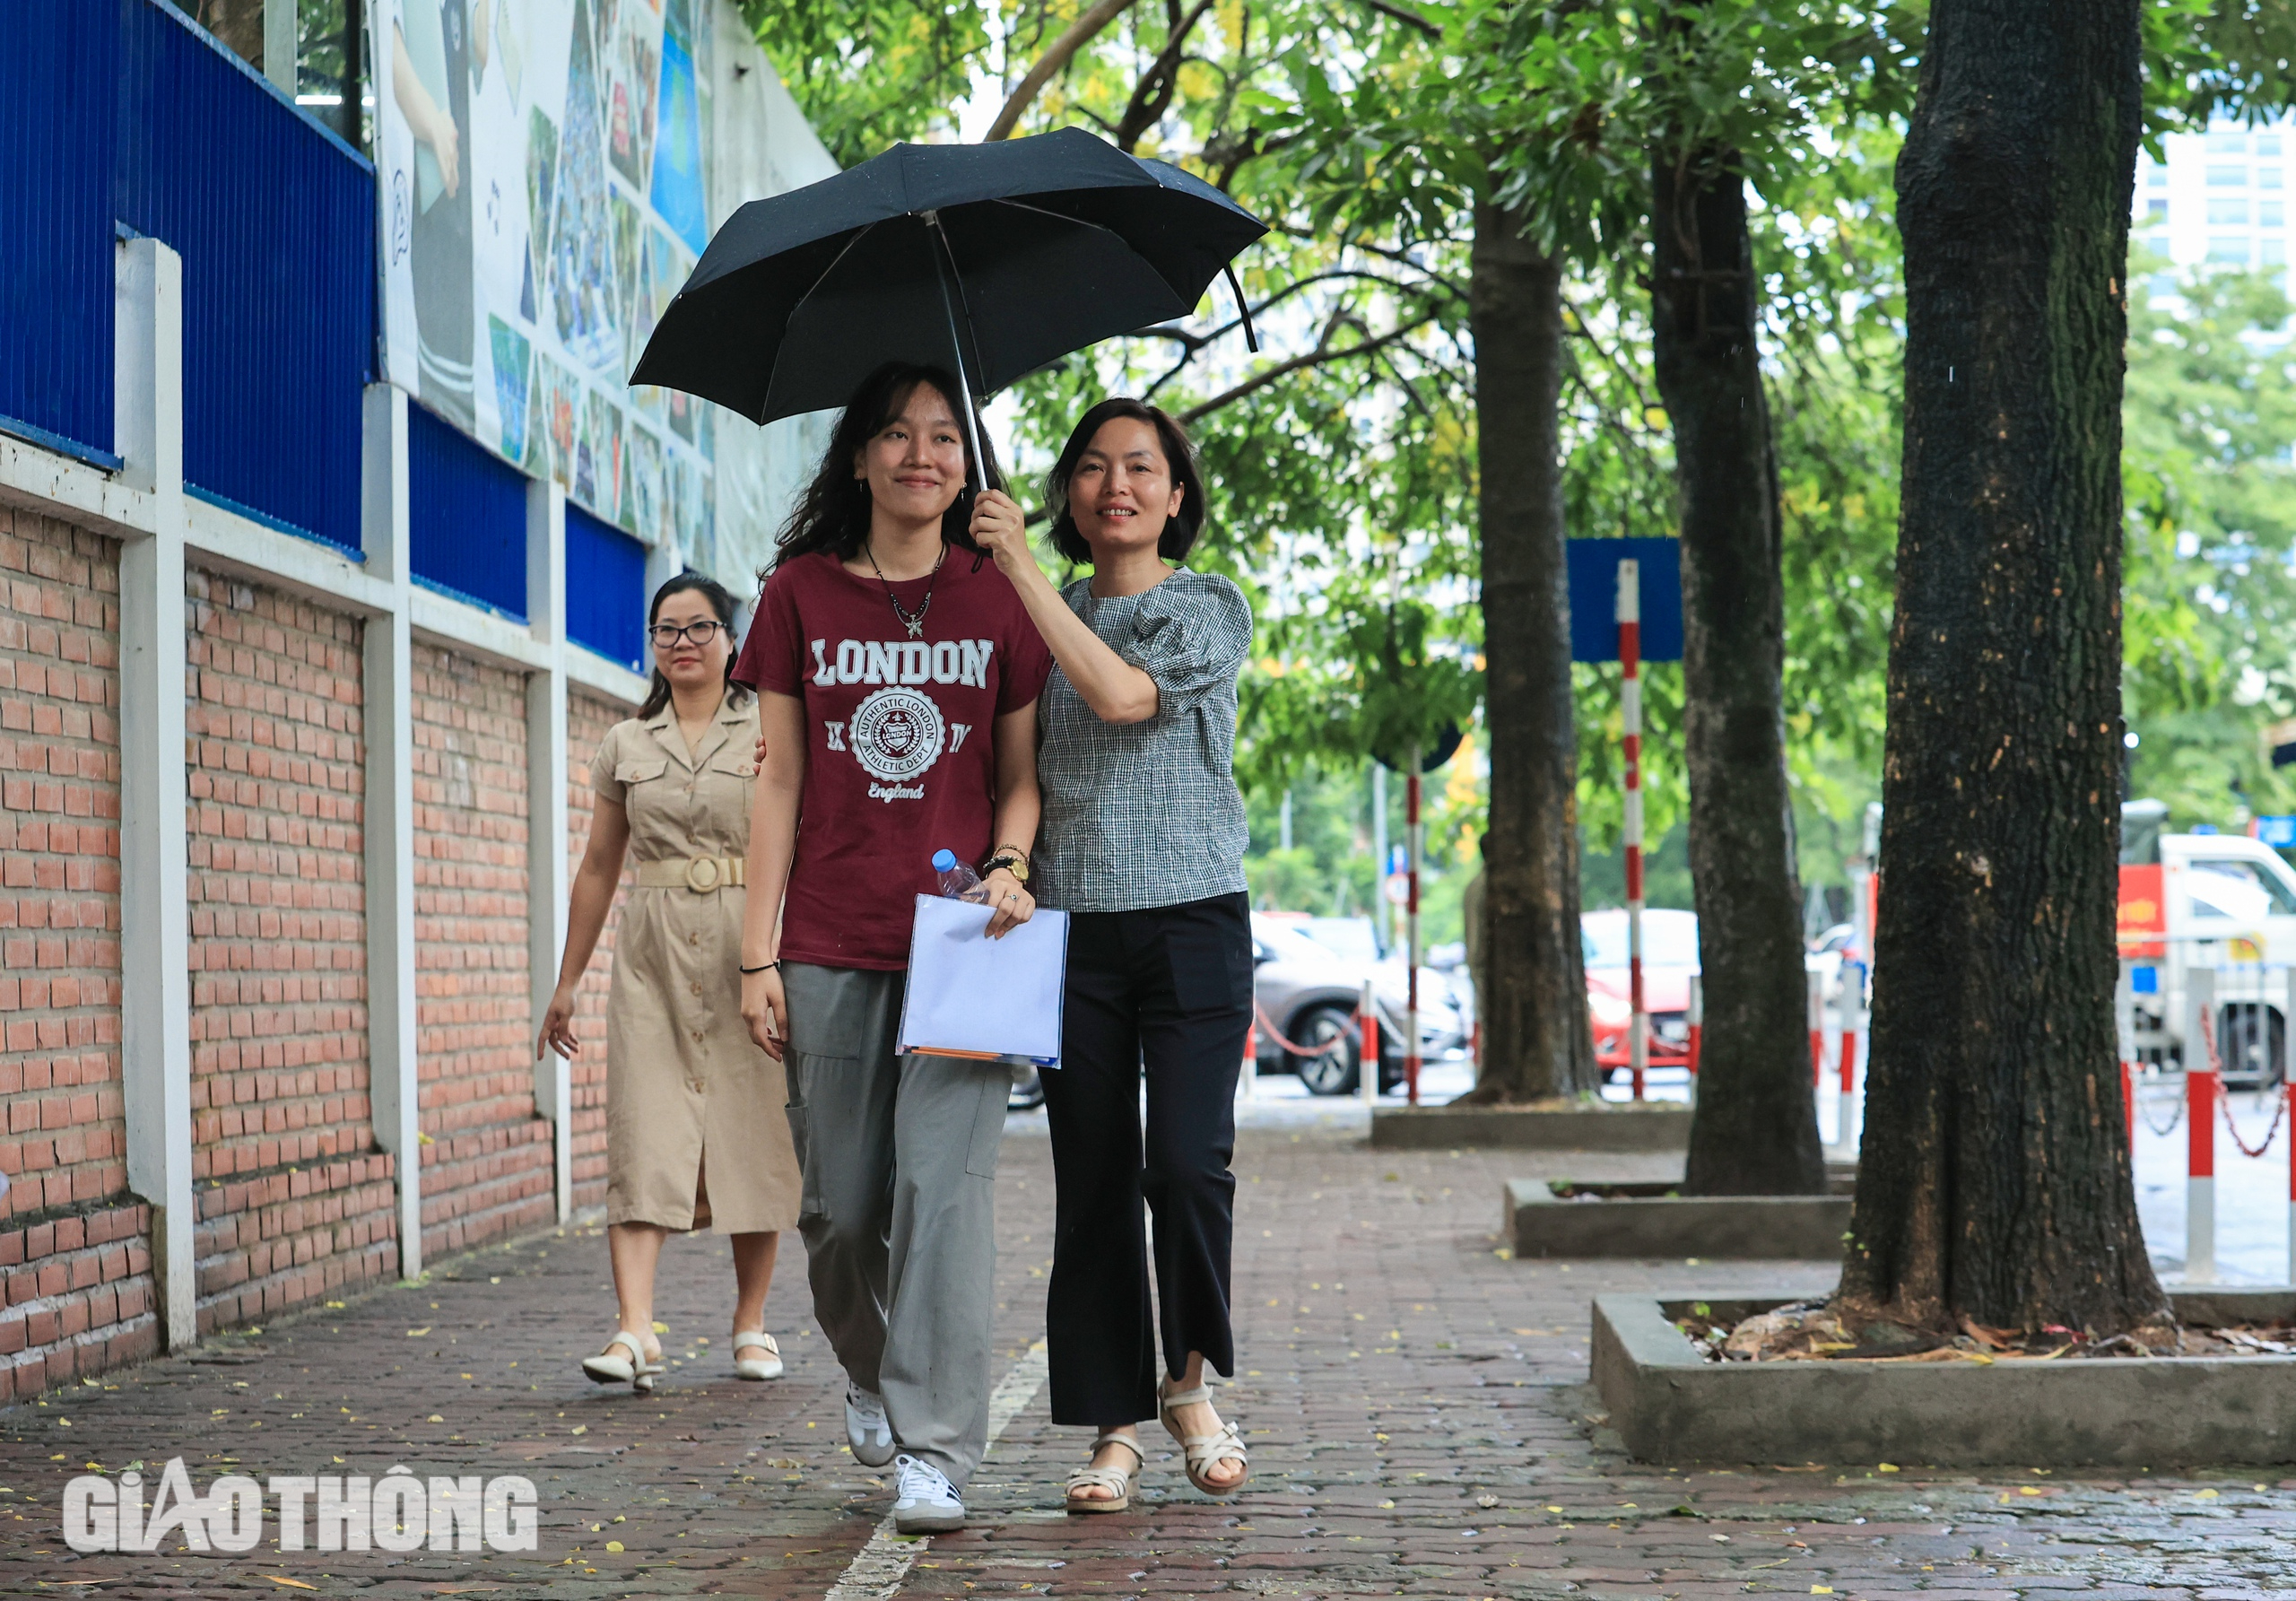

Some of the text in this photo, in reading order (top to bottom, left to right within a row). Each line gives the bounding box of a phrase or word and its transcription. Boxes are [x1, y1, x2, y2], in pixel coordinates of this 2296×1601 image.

[812, 639, 994, 689] LONDON
[861, 698, 935, 740] AUTHENTIC LONDON
[883, 730, 912, 740] LONDON
[863, 745, 928, 770] ATHLETIC DEPT
[867, 781, 925, 804] England
